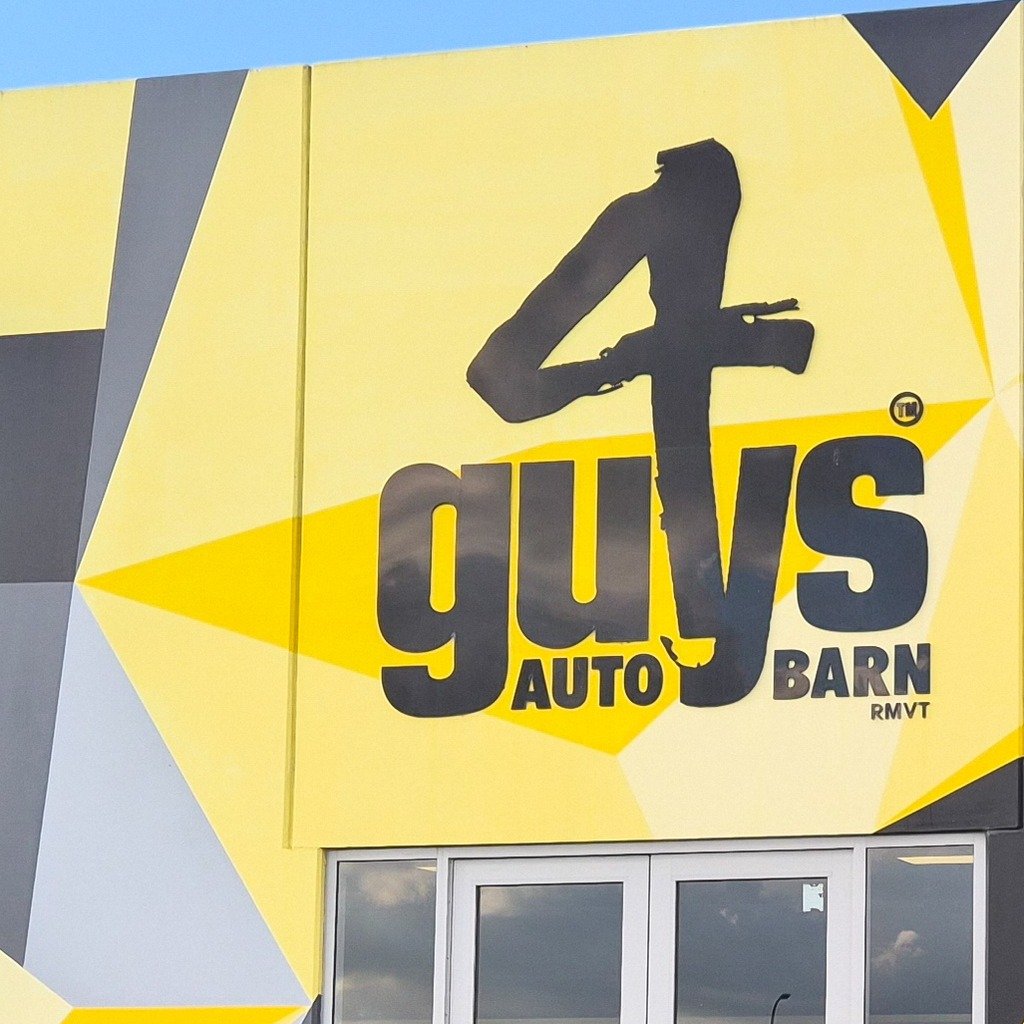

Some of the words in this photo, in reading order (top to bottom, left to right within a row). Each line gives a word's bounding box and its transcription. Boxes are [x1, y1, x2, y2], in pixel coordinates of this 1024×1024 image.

[466, 138, 815, 560] 4
[376, 434, 929, 719] guys
[511, 652, 664, 710] AUTO
[773, 643, 931, 701] BARN
[871, 701, 931, 720] RMVT
